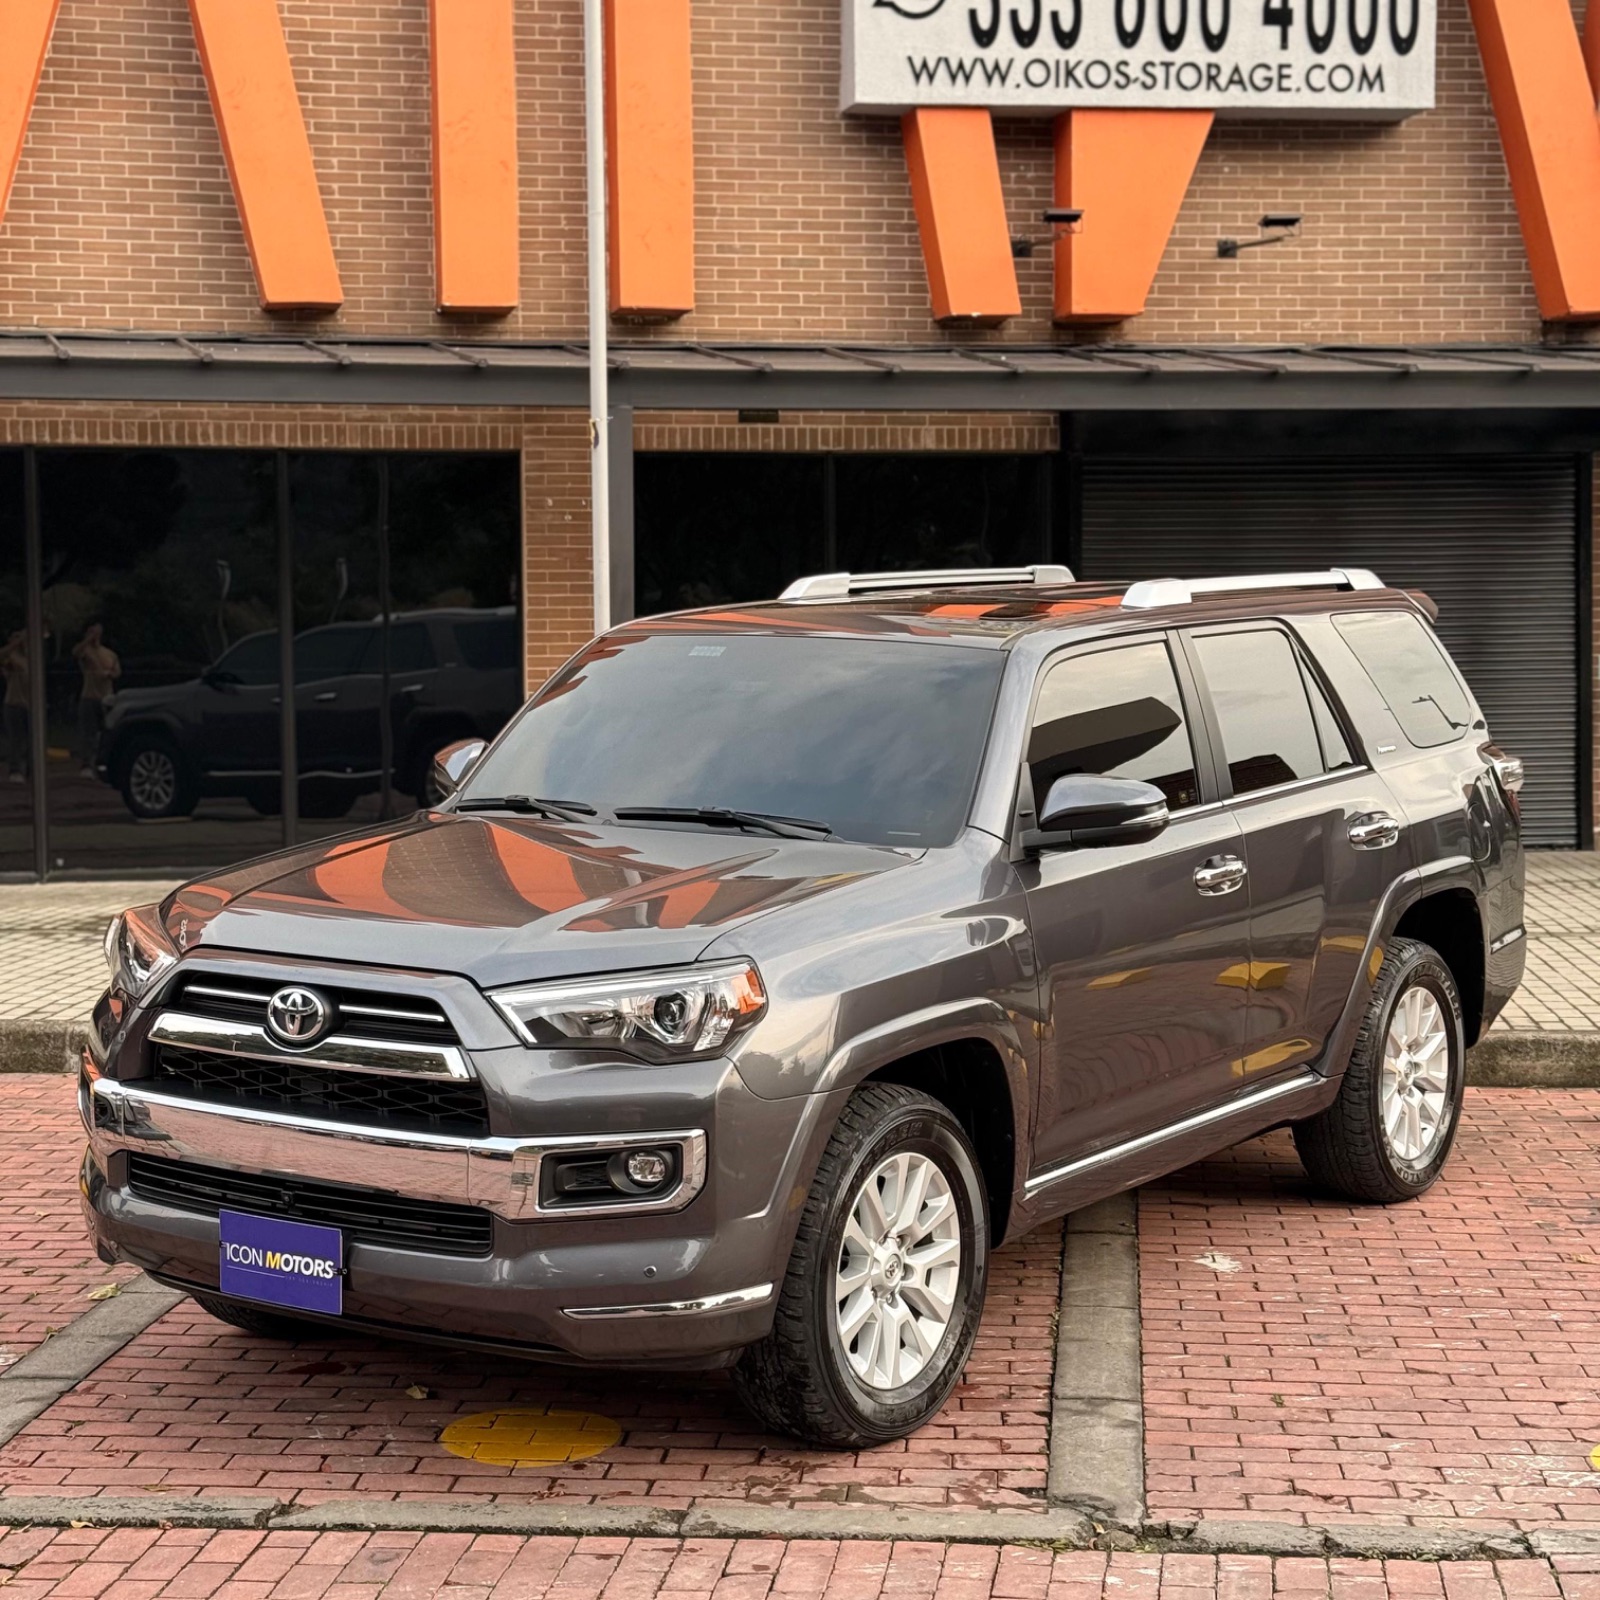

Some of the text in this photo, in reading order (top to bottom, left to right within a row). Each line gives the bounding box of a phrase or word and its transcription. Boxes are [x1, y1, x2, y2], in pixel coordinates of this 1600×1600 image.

[907, 55, 1386, 93] WWW.OIKOS-STORAGE.COM
[226, 1242, 335, 1279] ICON MOTORS
